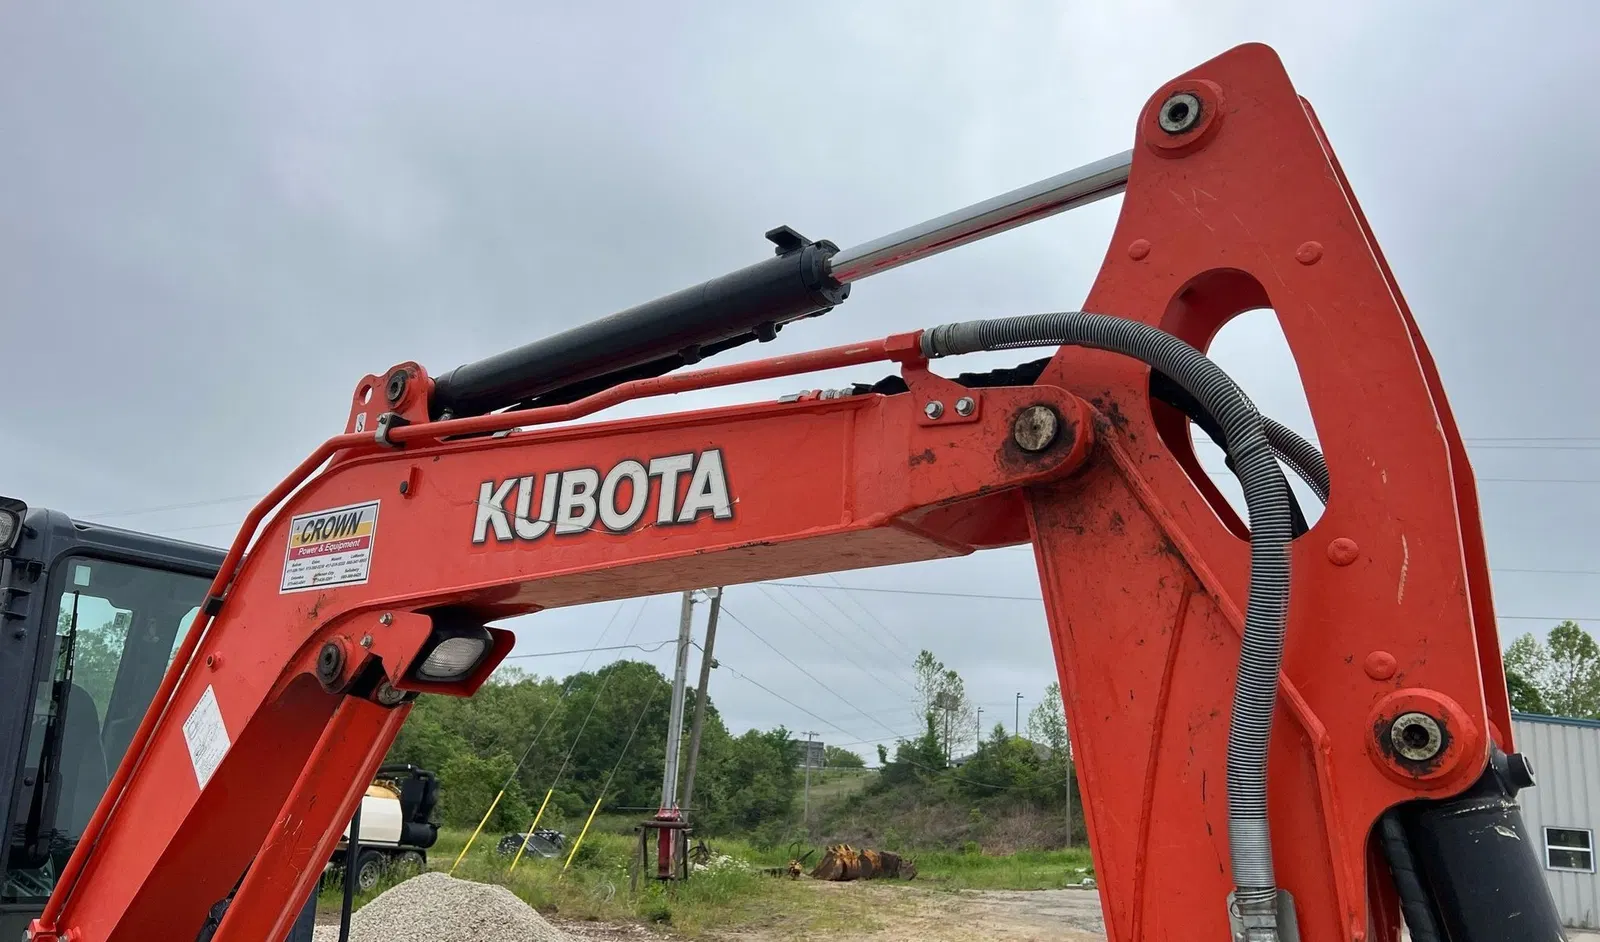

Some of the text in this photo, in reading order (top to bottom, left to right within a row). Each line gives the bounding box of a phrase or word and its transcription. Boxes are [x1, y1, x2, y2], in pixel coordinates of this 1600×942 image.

[472, 449, 732, 543] KUBOTA
[301, 511, 365, 544] CROWN
[298, 539, 361, 556] Power & Equipment
